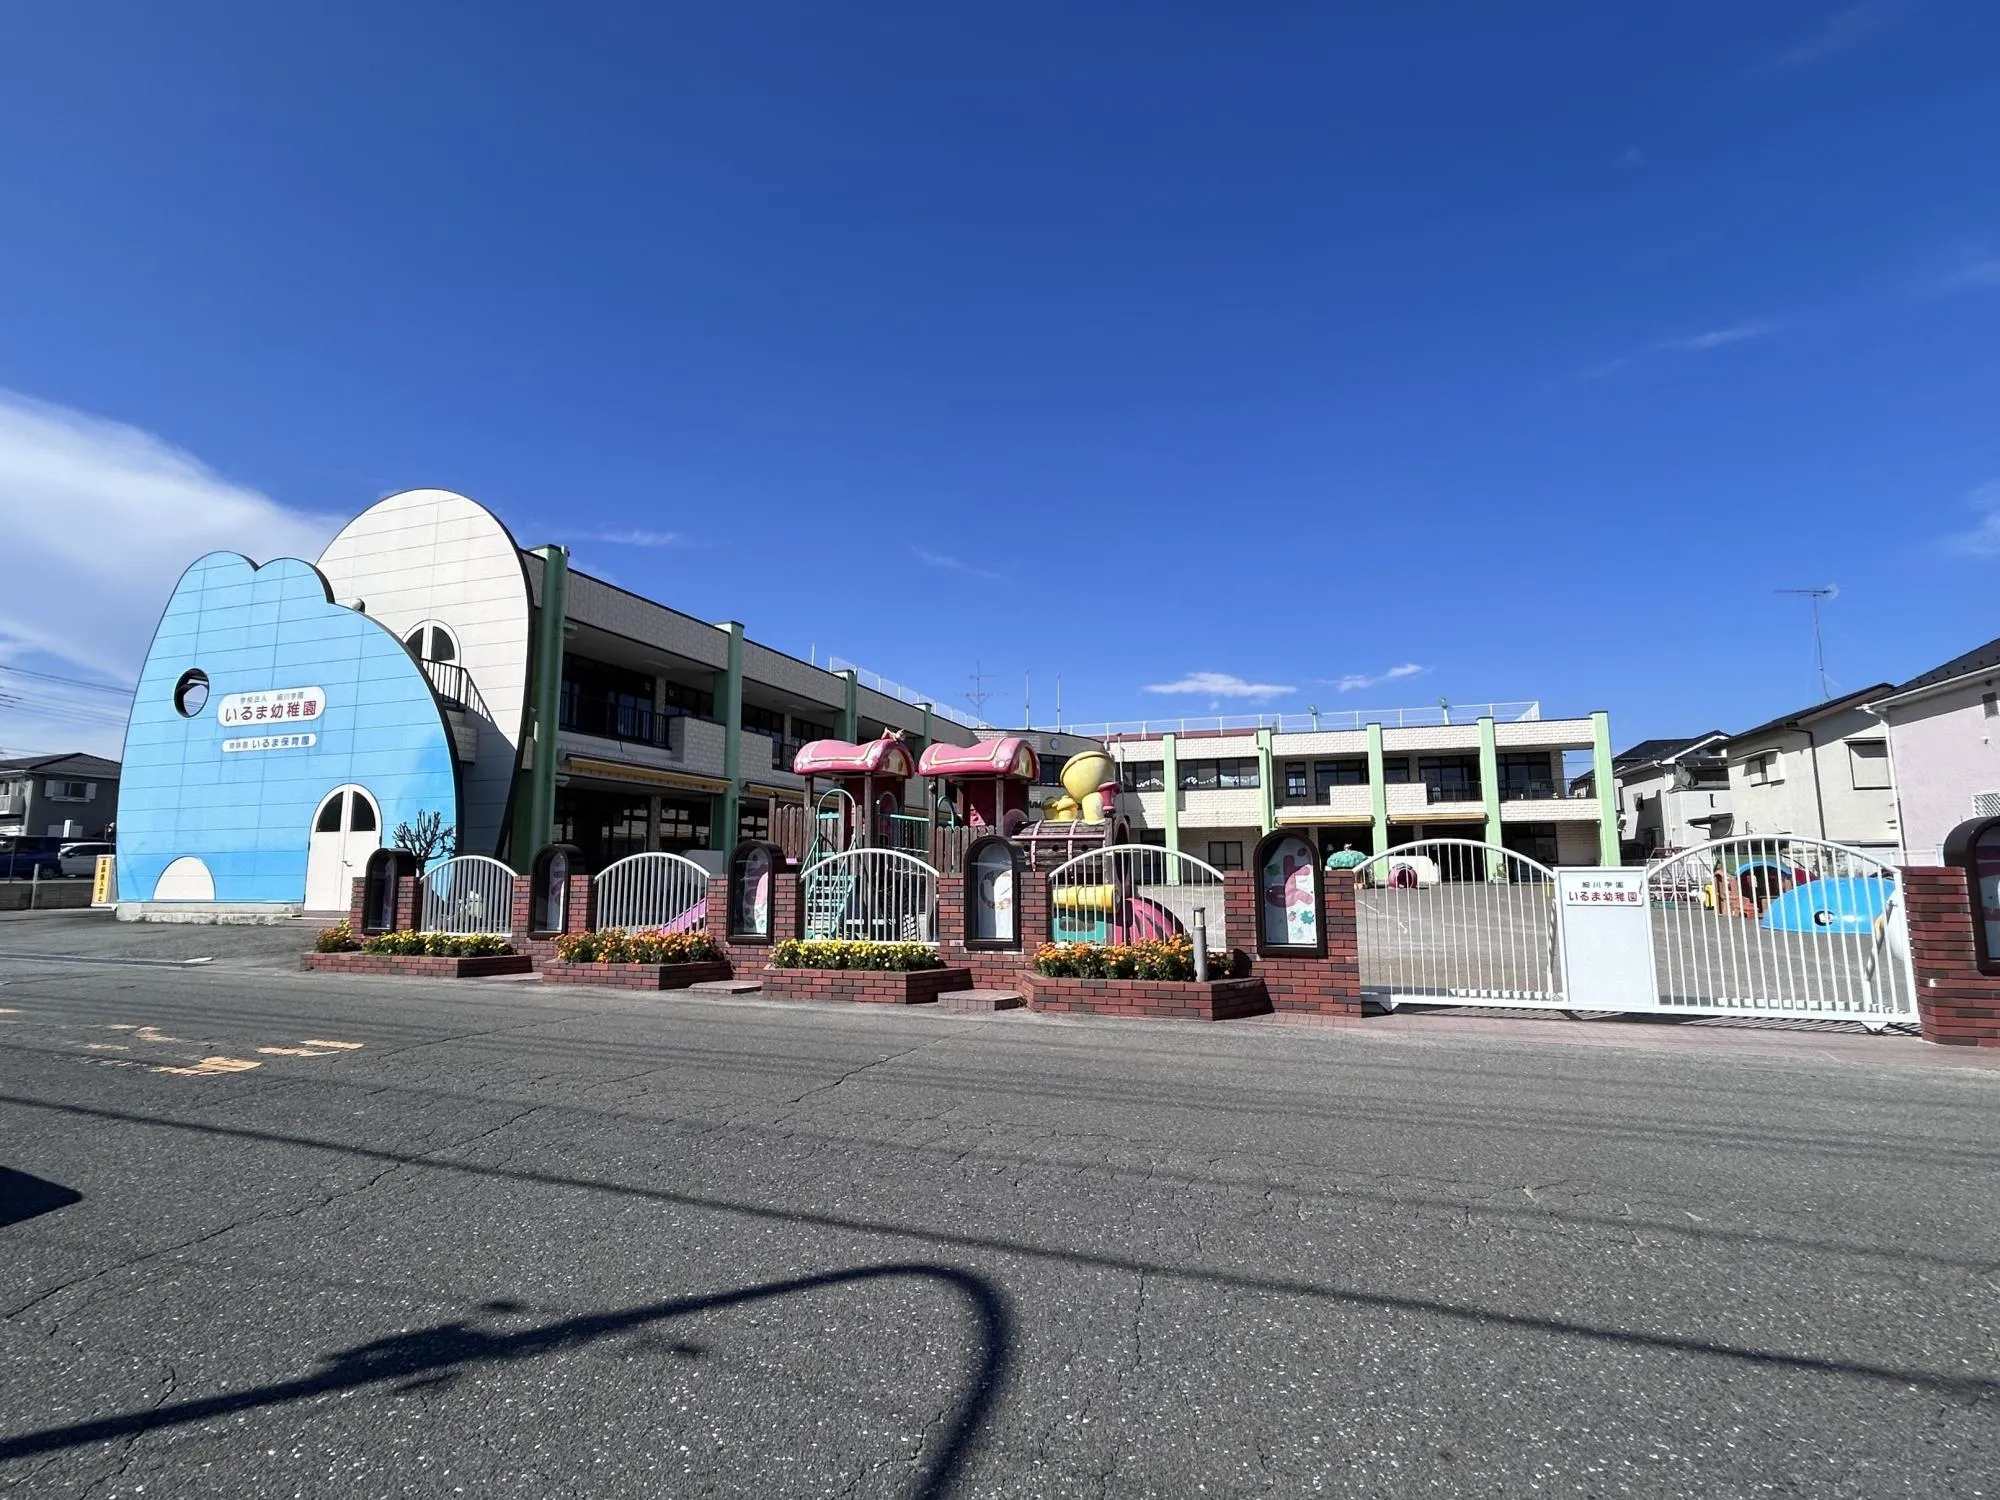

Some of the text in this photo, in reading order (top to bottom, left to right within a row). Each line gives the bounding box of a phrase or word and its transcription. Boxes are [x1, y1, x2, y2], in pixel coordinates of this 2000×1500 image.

[225, 701, 316, 721] いるま幼稚園
[252, 736, 310, 748] いるま保育園
[1569, 892, 1637, 902] いるま幼稚園
